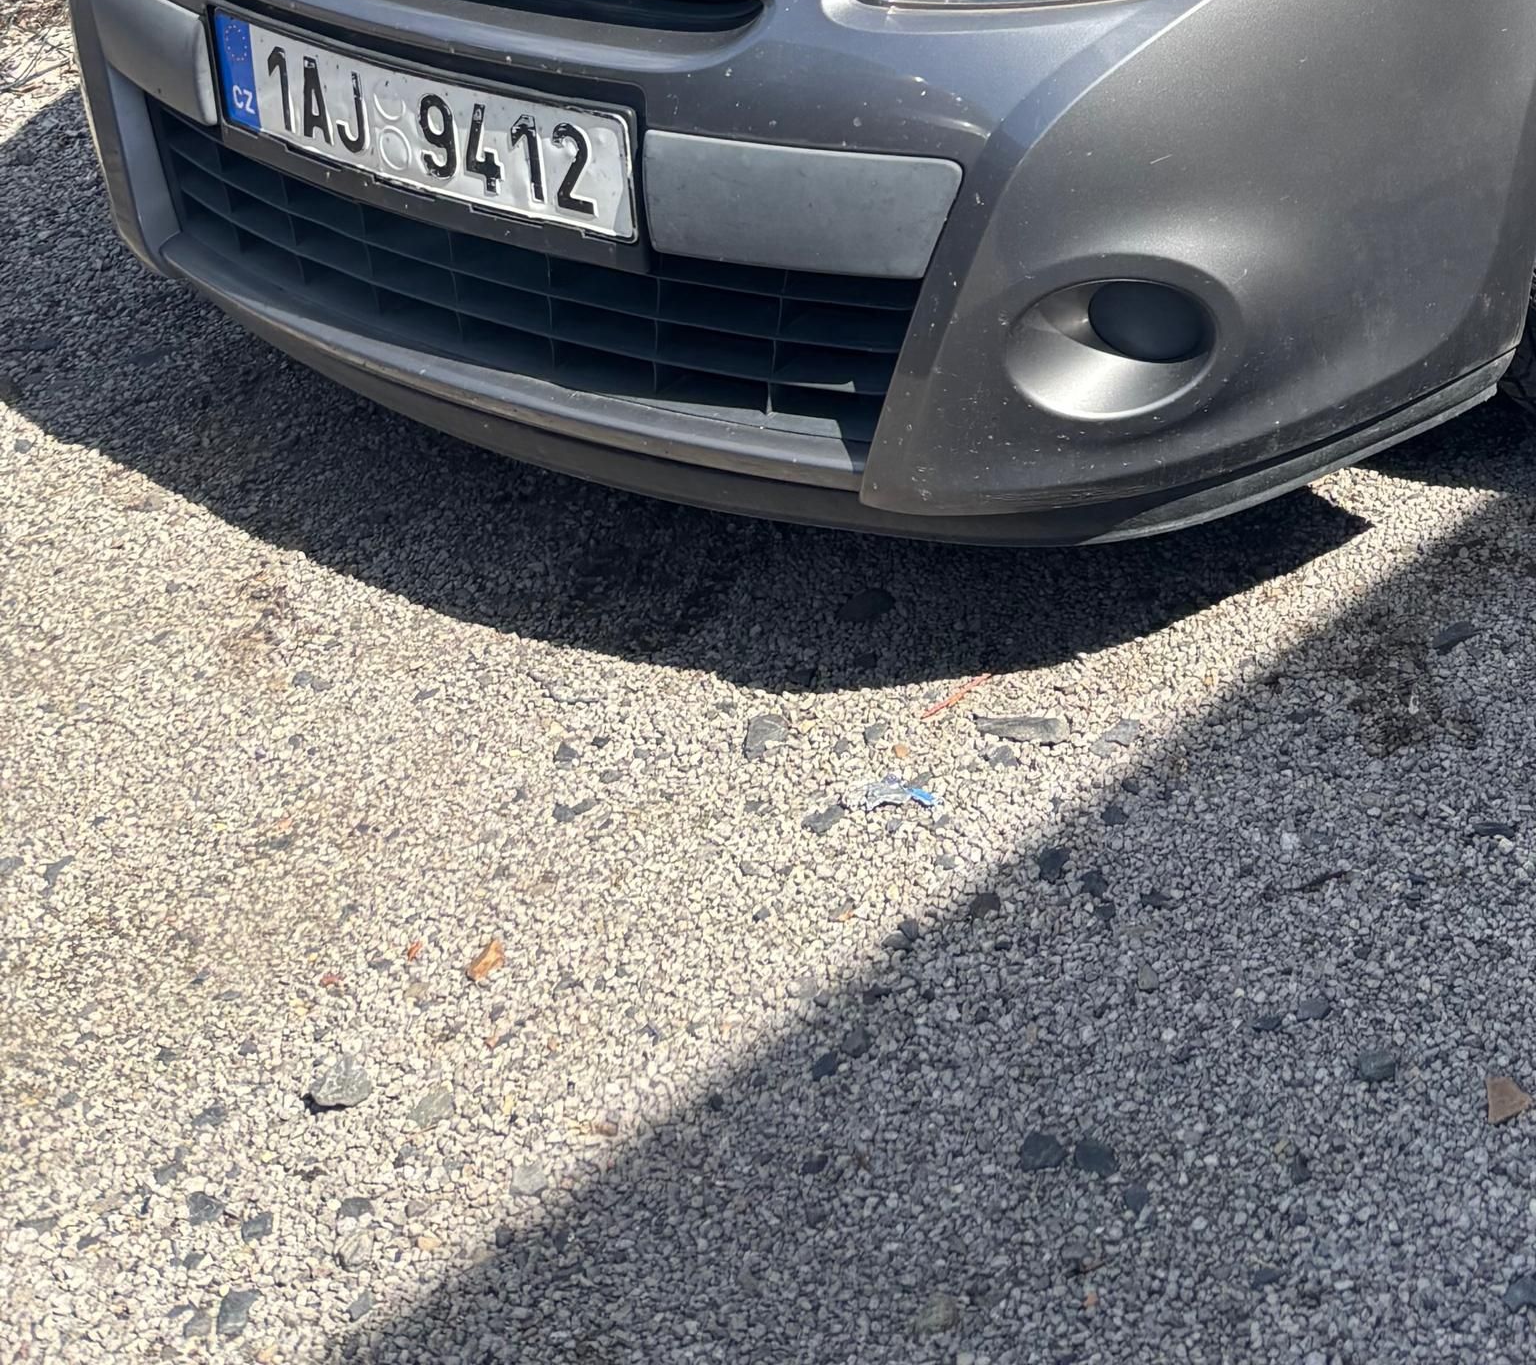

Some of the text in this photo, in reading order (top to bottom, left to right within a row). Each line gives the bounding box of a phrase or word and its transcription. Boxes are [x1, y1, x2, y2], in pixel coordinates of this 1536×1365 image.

[233, 85, 255, 114] CZ
[267, 46, 598, 218] 1AJ 9412
